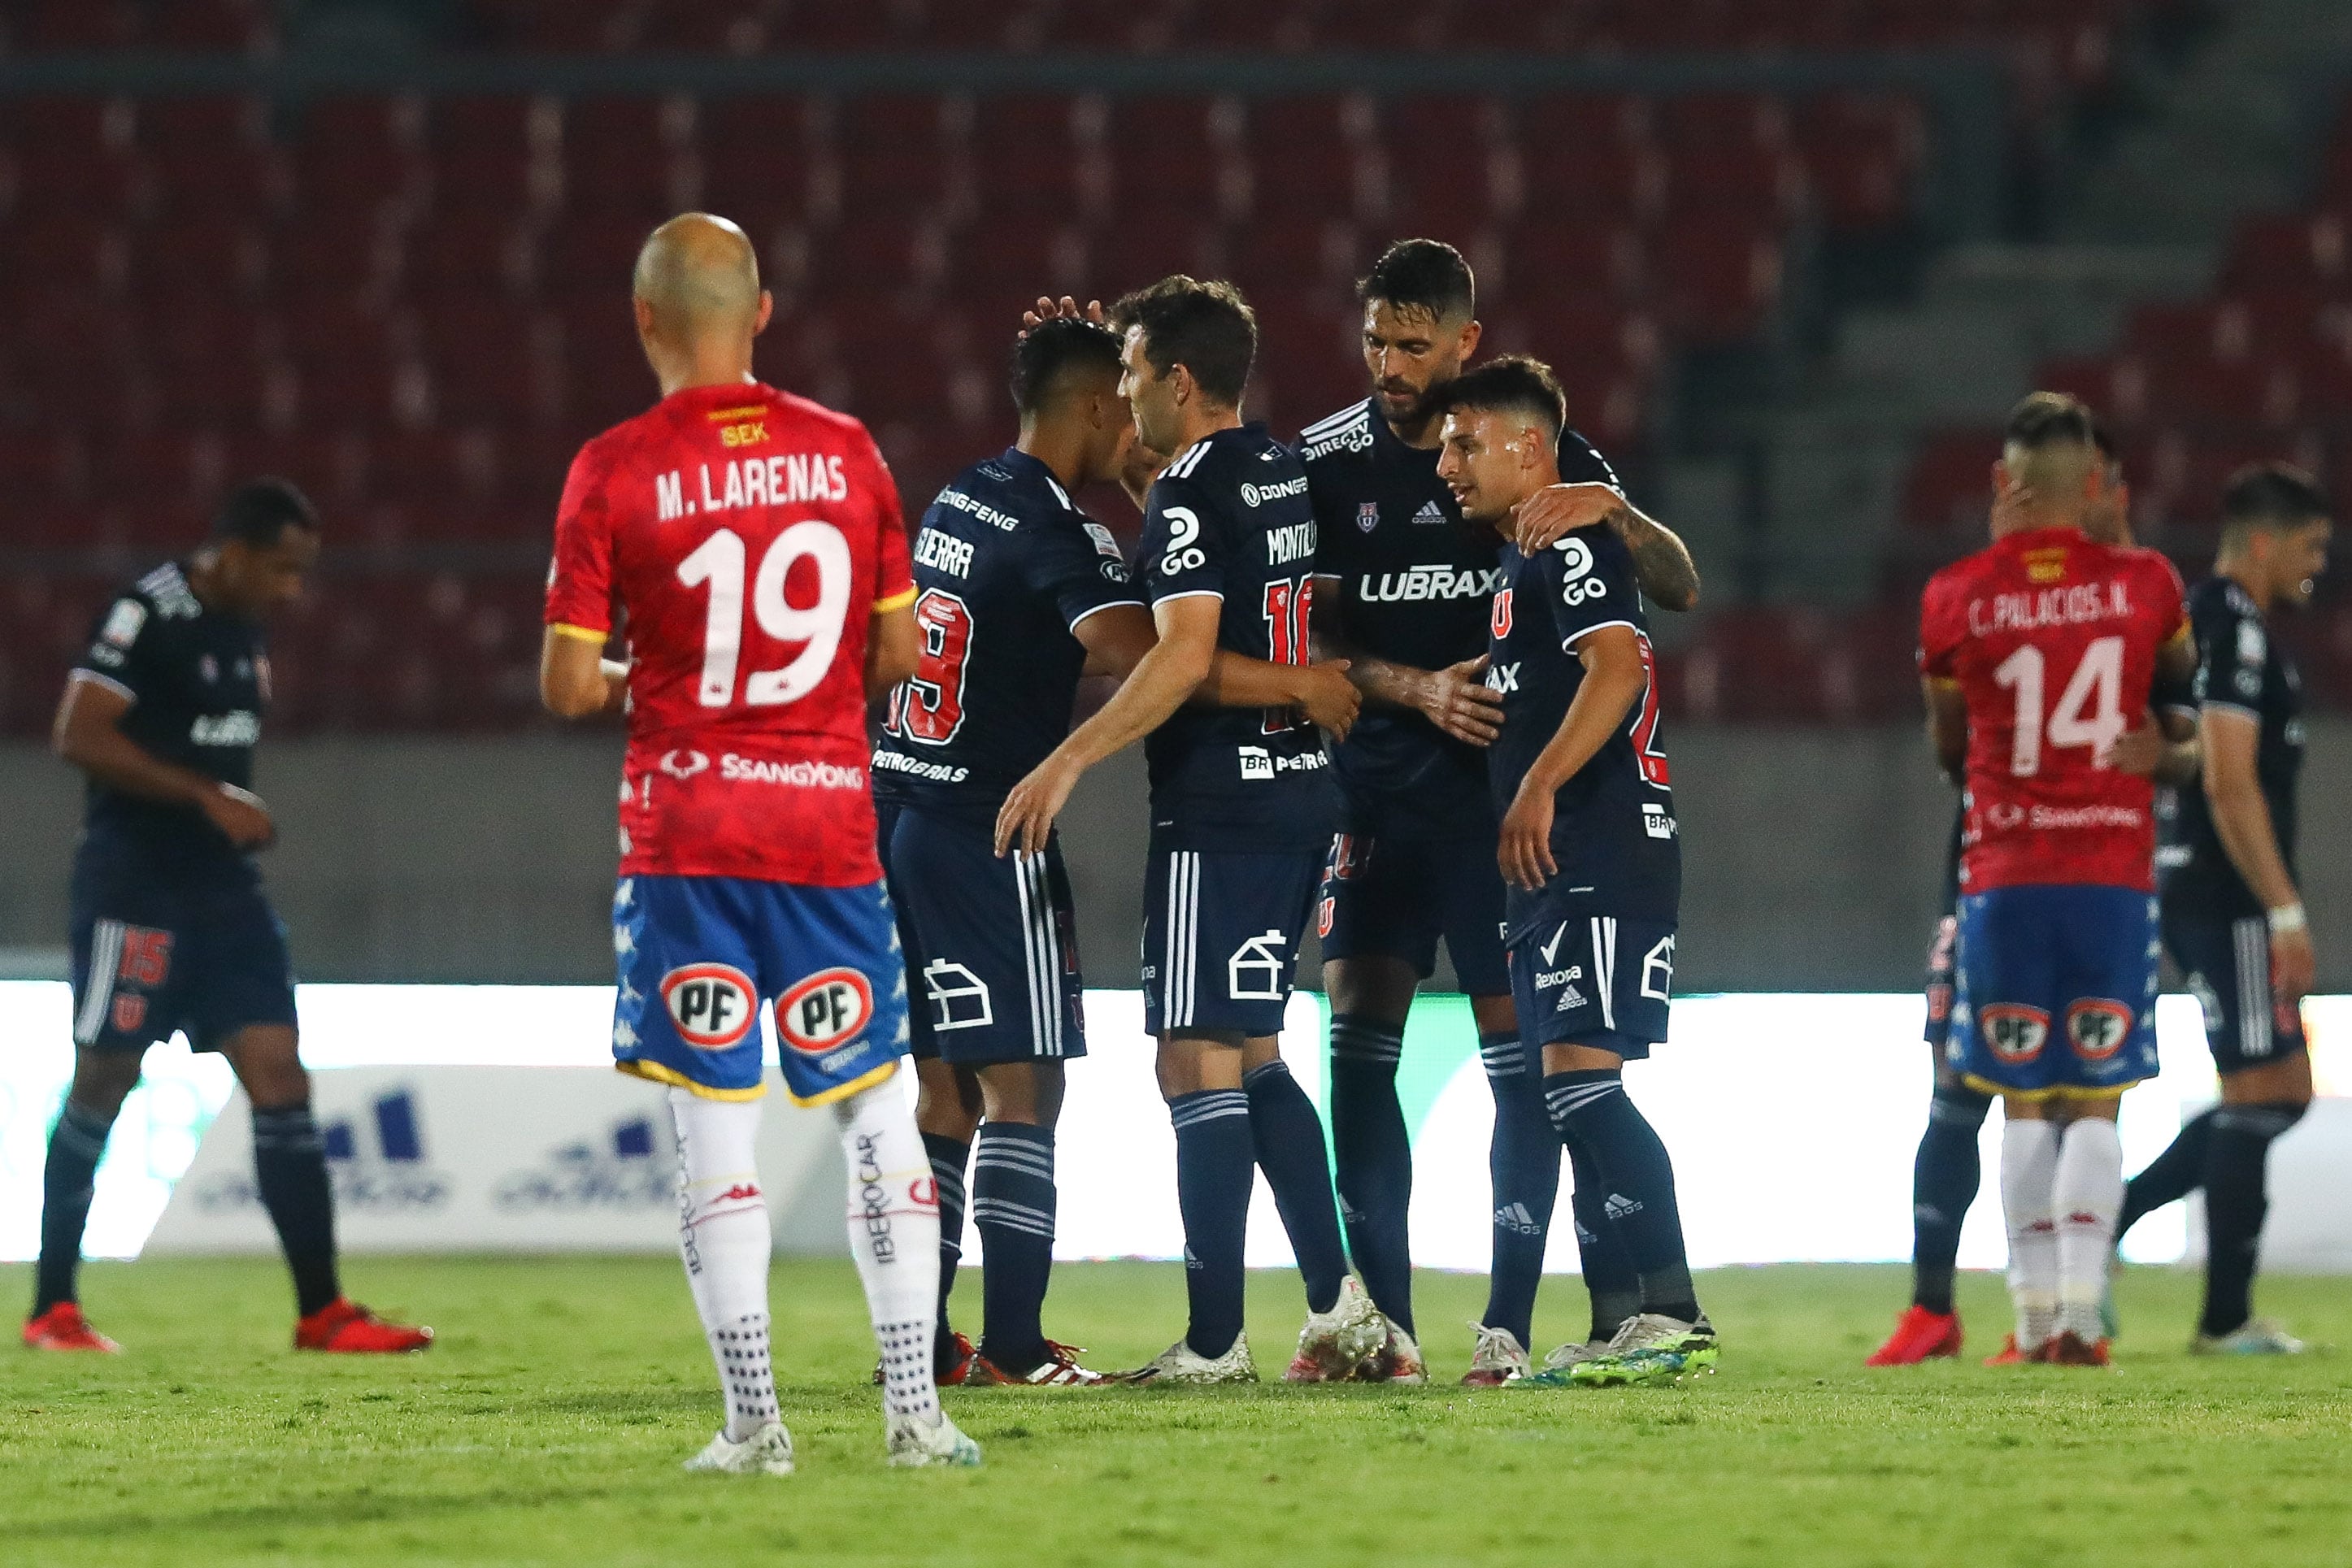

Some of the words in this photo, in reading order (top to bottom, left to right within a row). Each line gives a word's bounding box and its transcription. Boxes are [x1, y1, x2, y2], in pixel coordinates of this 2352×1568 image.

[1300, 420, 1369, 462] DIRECTV
[1349, 433, 1374, 453] GO
[656, 470, 697, 522] M.
[700, 453, 848, 512] LARENAS
[1161, 551, 1206, 576] GO
[1359, 567, 1502, 602] LUBRAX
[676, 519, 853, 708] 19
[1563, 577, 1607, 606] GO
[1993, 636, 2128, 777] 14
[871, 749, 969, 783] PETROBRAS
[680, 982, 736, 1032] PF
[802, 984, 847, 1036] PF
[857, 1130, 895, 1264] IBEROCAR
